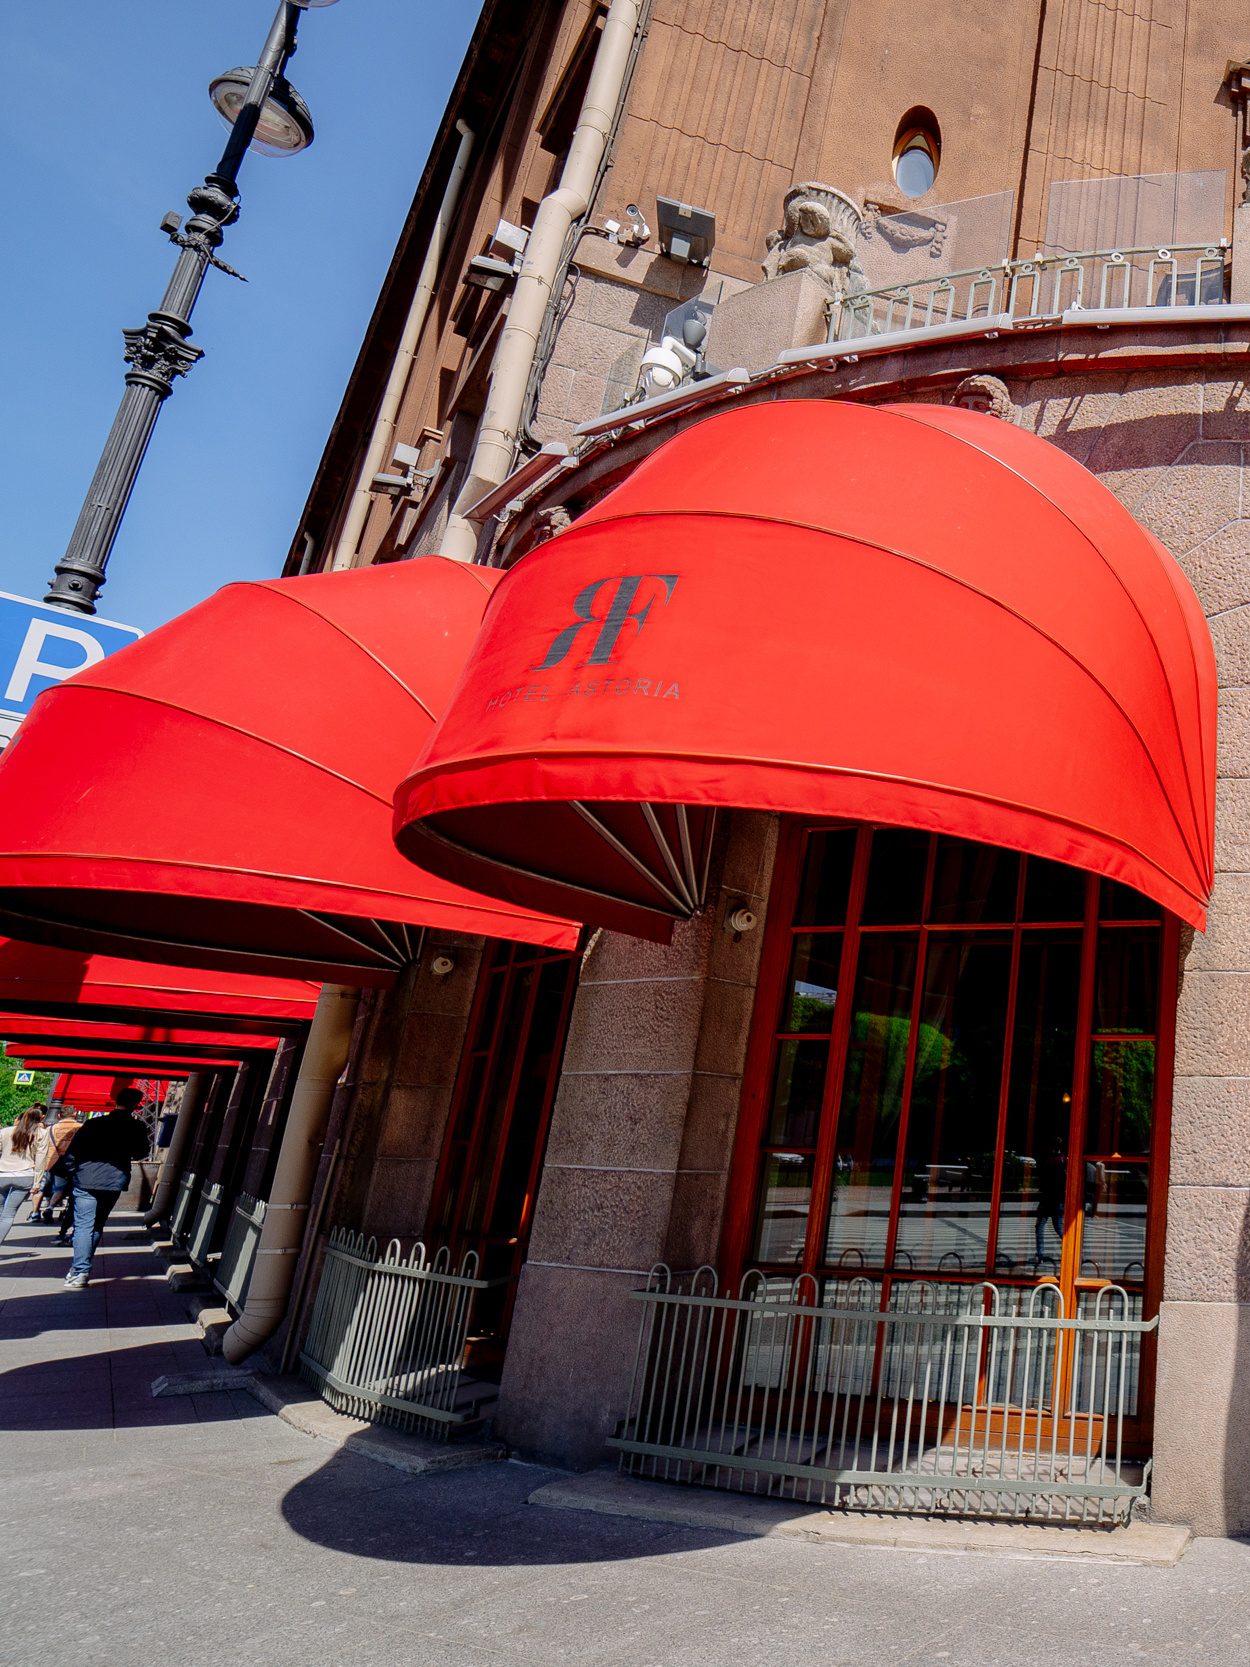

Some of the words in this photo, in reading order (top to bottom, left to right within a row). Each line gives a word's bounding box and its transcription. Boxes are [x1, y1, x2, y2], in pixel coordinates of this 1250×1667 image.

[4, 617, 105, 703] P
[485, 685, 550, 712] HOTEL
[566, 678, 680, 700] ASTORIA
